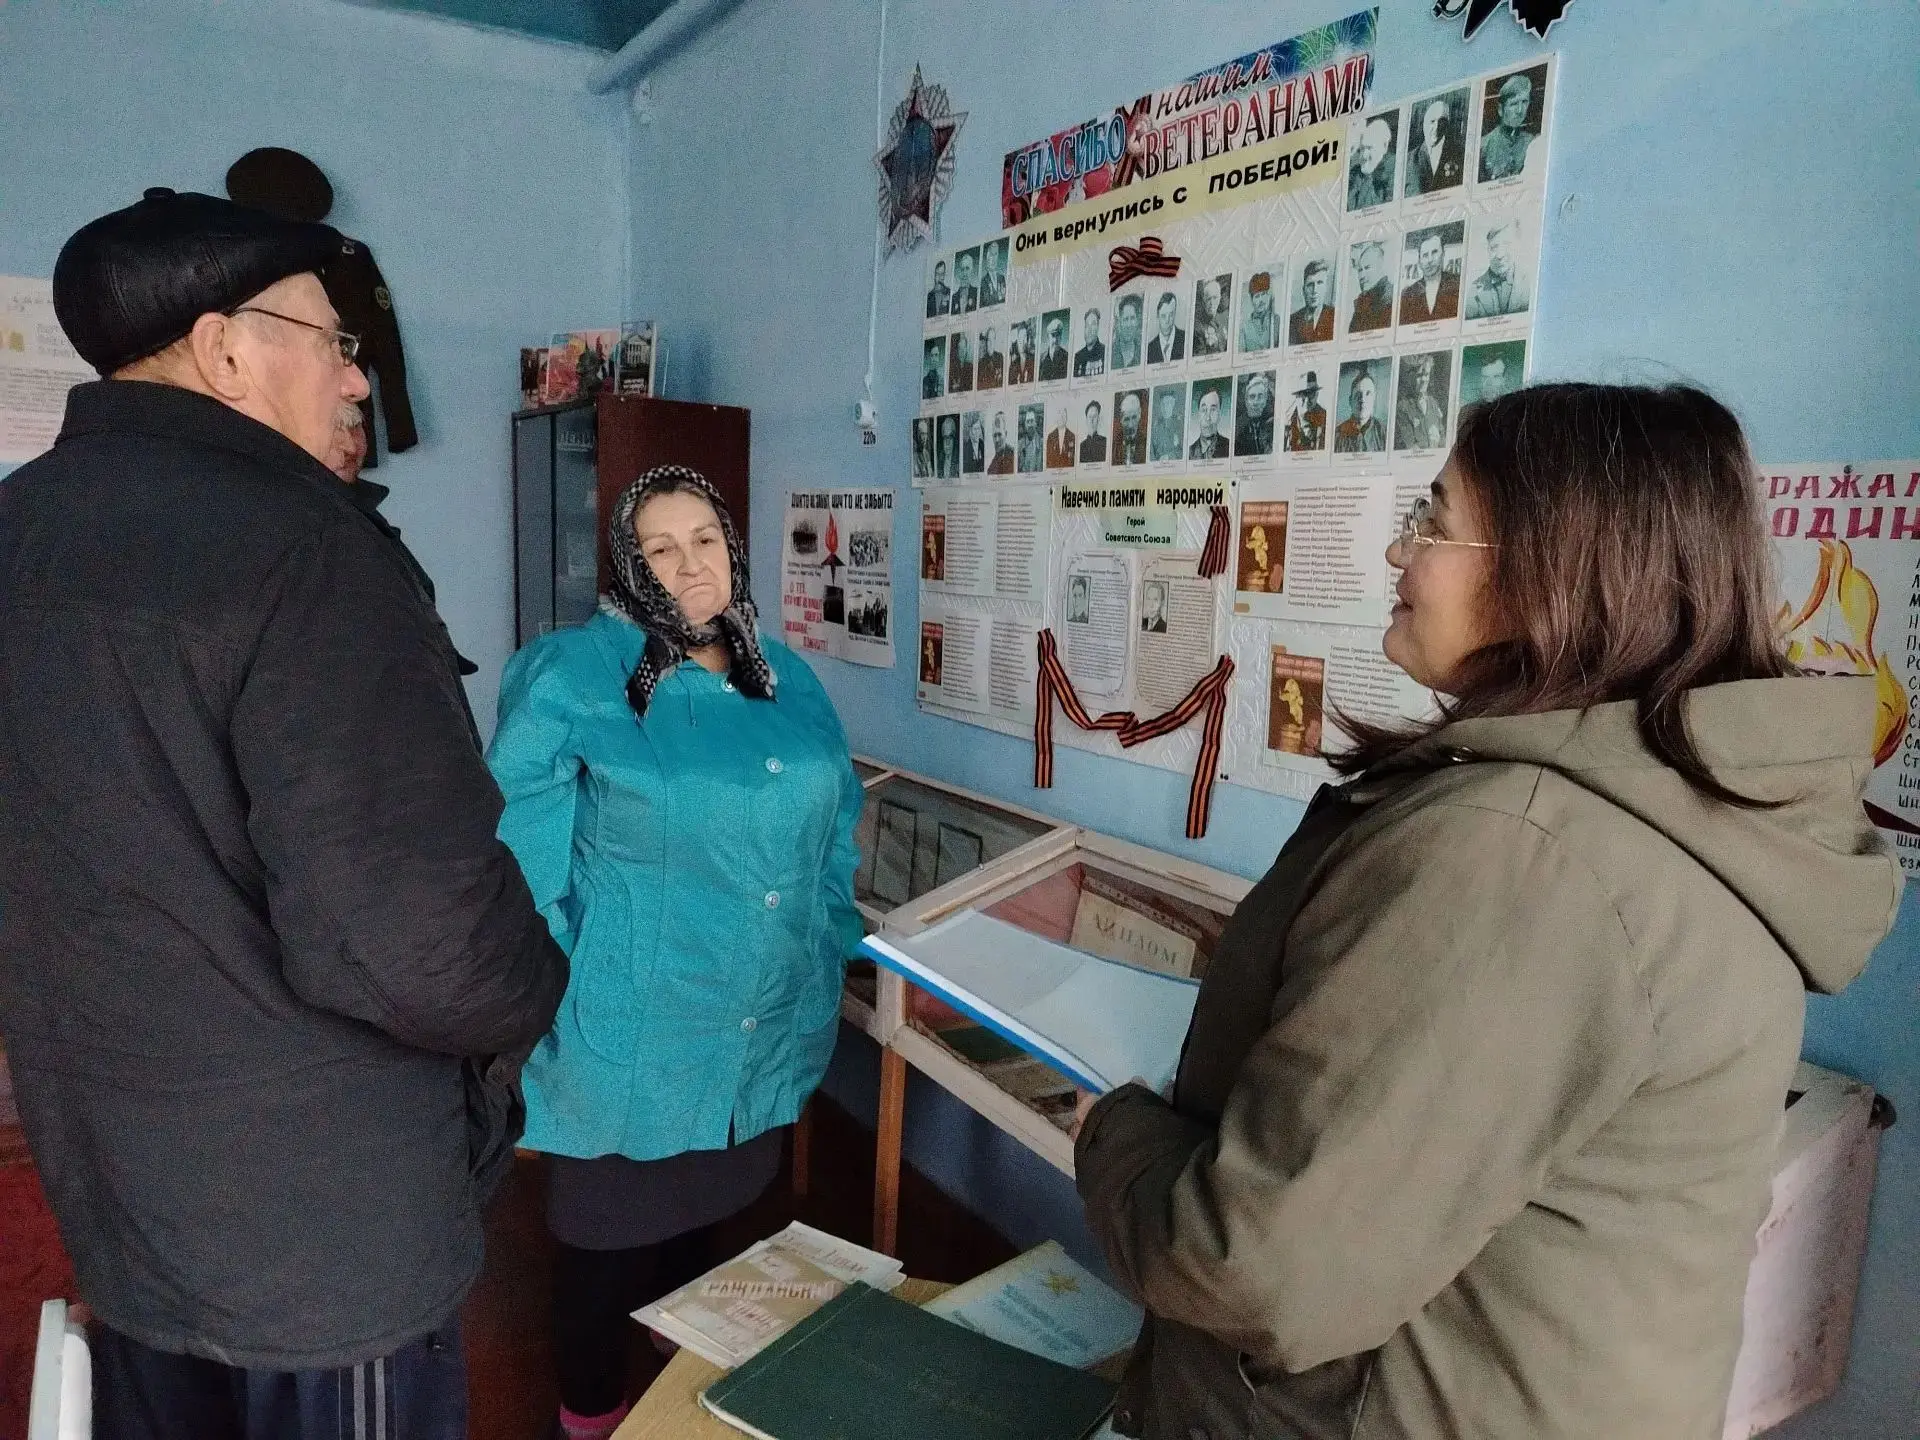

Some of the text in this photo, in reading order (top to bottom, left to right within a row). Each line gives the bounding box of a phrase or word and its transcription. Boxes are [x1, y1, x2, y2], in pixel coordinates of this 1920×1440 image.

[1156, 52, 1272, 117] нашим
[1011, 54, 1371, 197] СПАСИБО ВЕТЕРАНАМ!
[1015, 229, 1047, 253] Они
[1054, 196, 1164, 241] вернулись
[1208, 140, 1339, 194] ПОБЕДОЙ!
[1061, 482, 1223, 509] Навечно в памяти народной
[1105, 532, 1170, 544] Советского Союза
[1126, 516, 1145, 526] Герой
